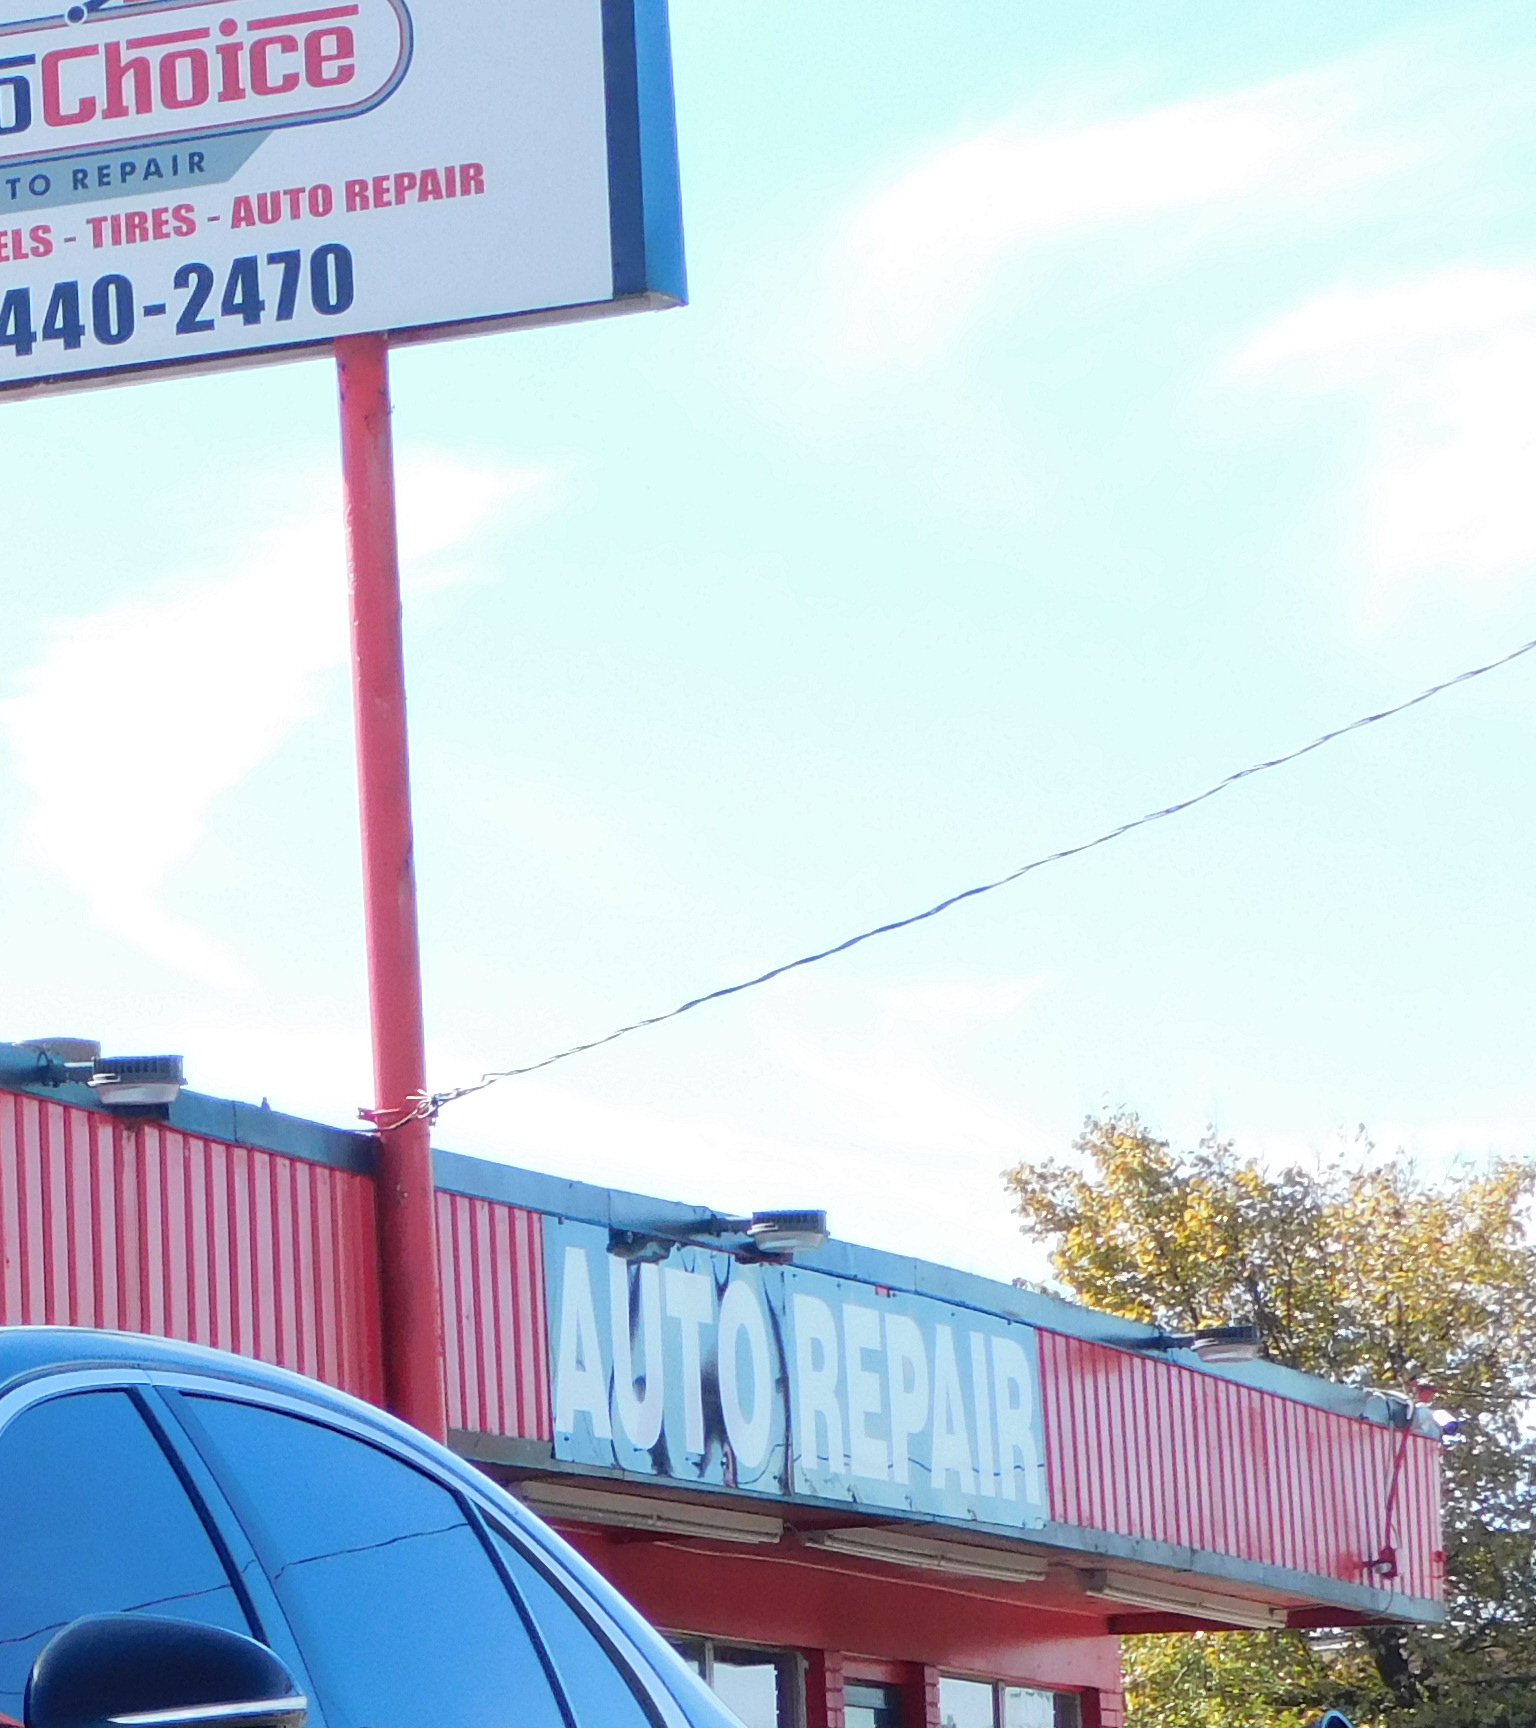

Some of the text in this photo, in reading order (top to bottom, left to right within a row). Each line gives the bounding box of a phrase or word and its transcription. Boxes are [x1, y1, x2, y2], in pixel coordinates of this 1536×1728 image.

[71, 151, 207, 191] REPAIR
[85, 203, 197, 249] TIRES
[230, 183, 334, 229] AUTO
[344, 162, 486, 213] REPAIR
[555, 1246, 1043, 1506] AUTO REPAIR
